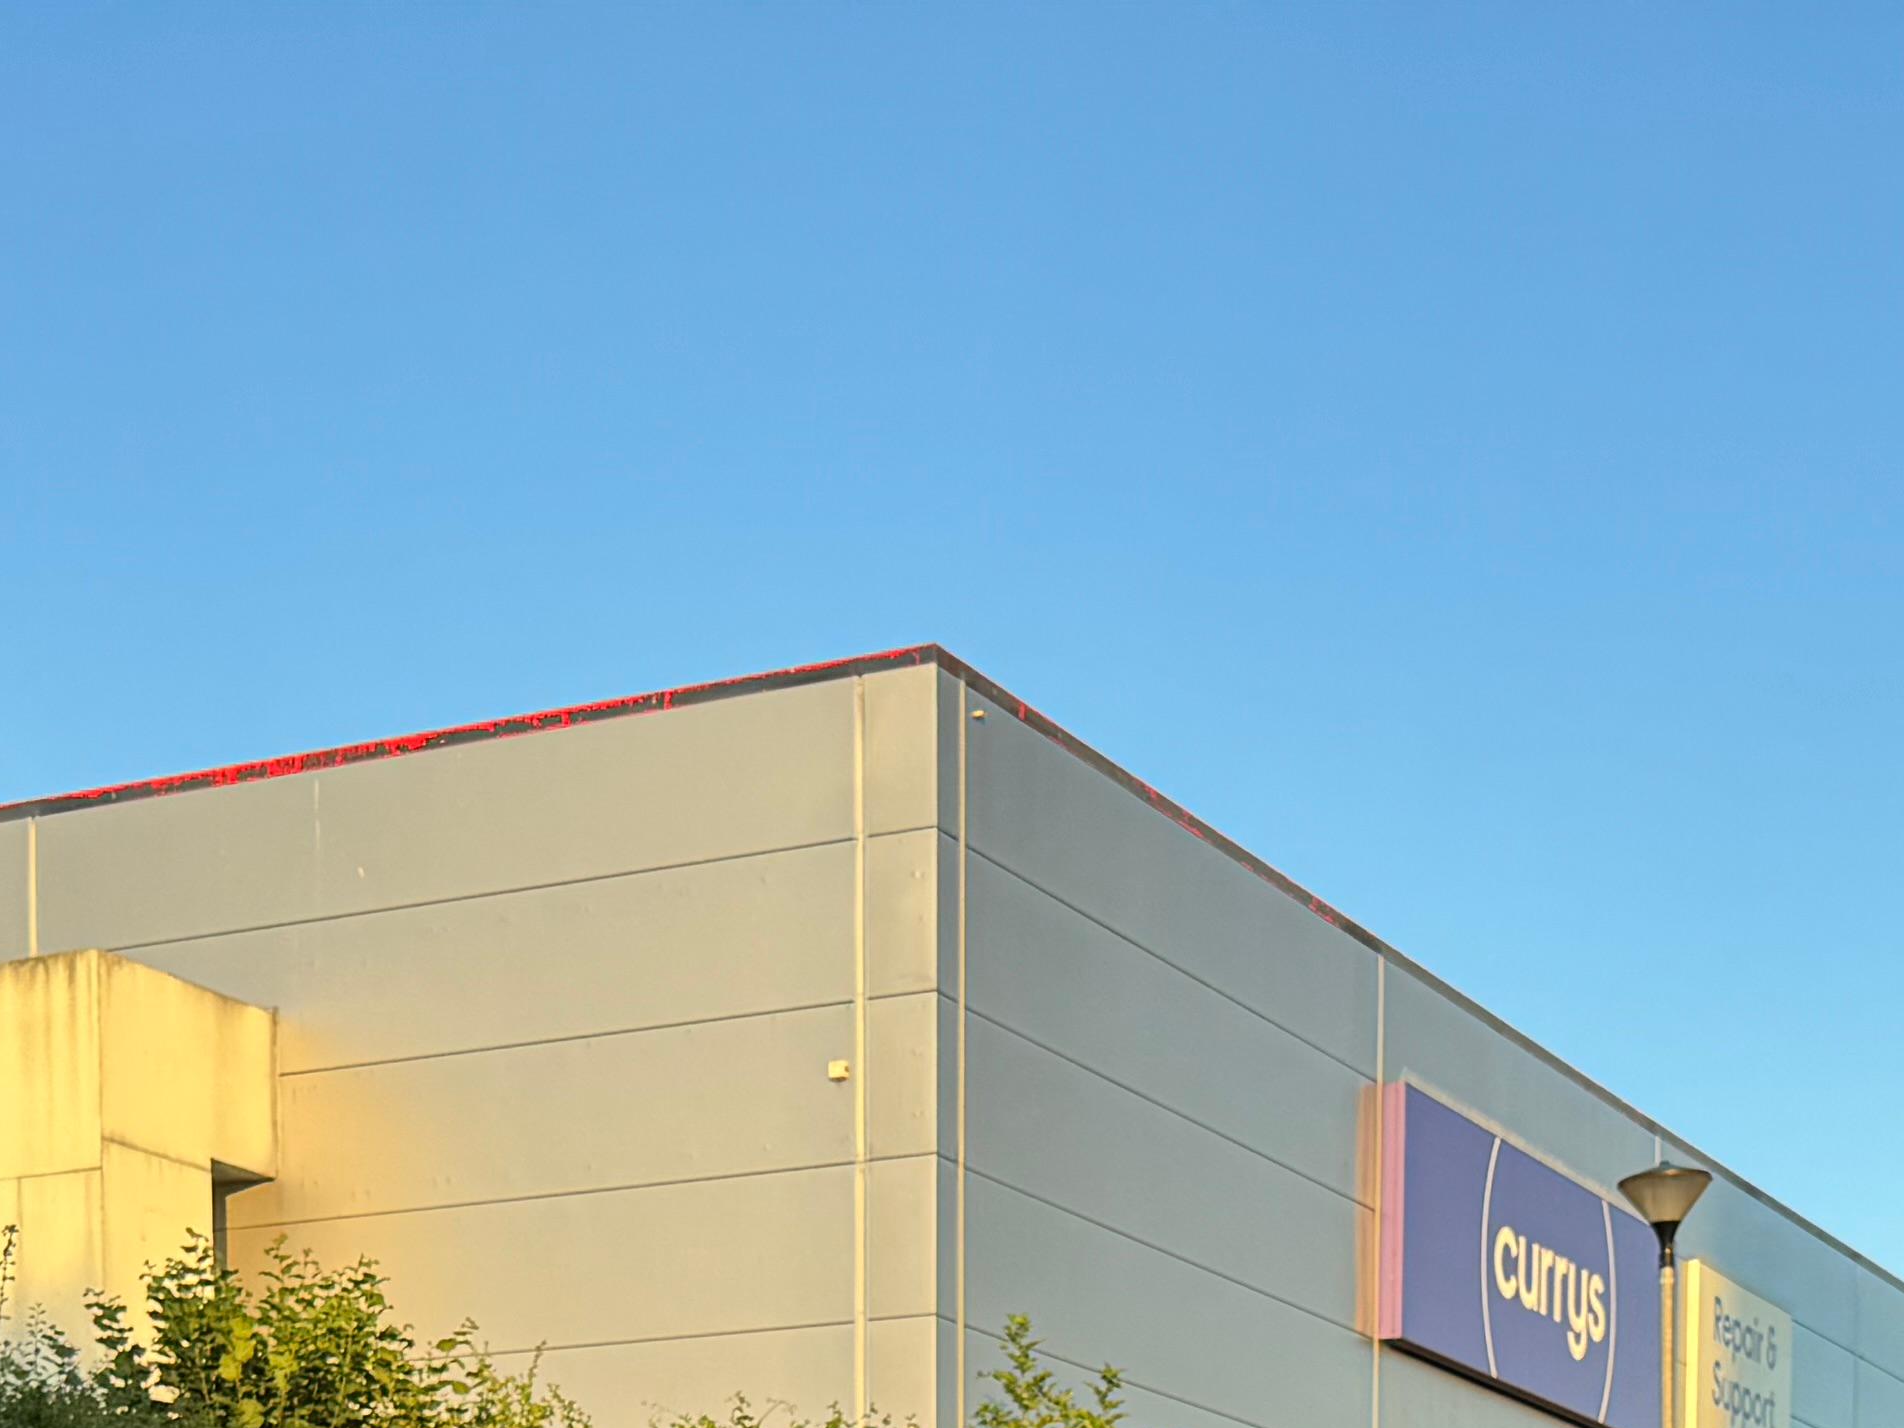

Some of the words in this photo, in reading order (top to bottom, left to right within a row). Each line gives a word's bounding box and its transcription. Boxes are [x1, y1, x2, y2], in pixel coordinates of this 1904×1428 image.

[1493, 1225, 1606, 1361] currys
[1714, 1295, 1764, 1364] Repair
[1766, 1325, 1777, 1371] &
